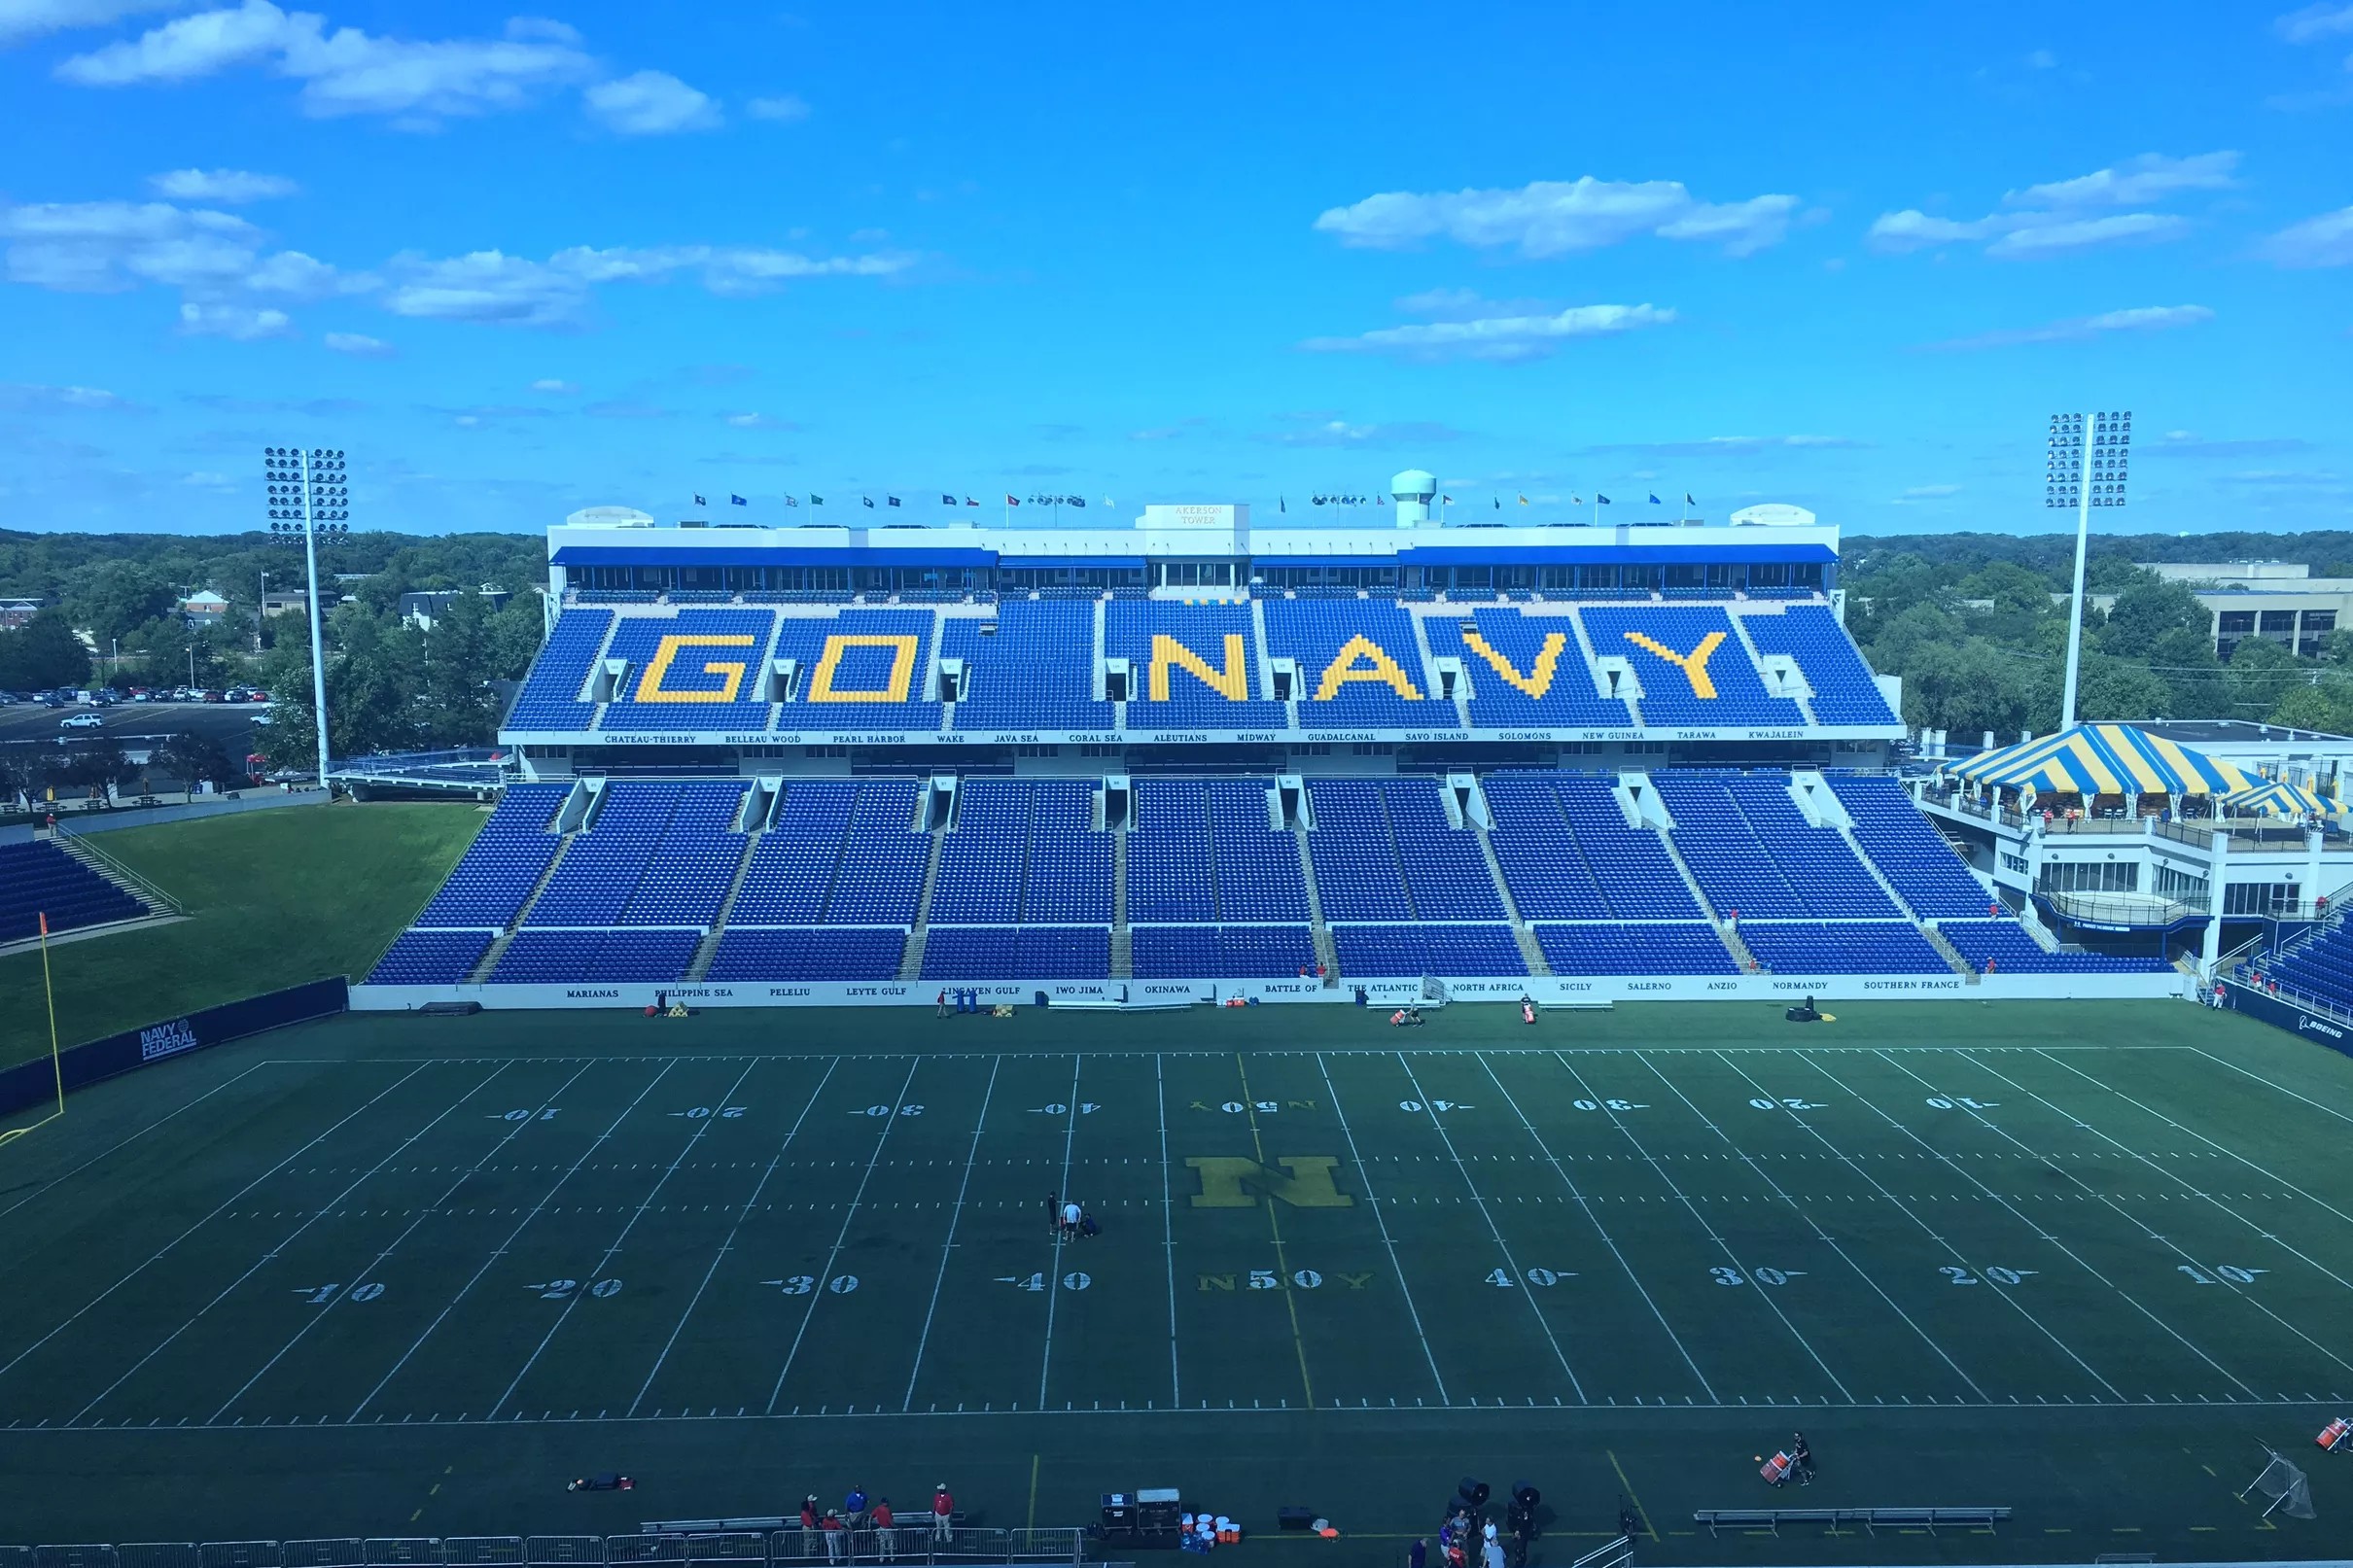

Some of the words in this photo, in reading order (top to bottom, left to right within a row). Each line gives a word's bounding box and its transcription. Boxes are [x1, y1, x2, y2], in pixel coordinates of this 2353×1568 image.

[635, 635, 918, 703] GO
[1148, 633, 1727, 702] NAVY
[567, 990, 619, 998] MARIANAS
[654, 989, 711, 997] PHILIPPINE
[1489, 983, 1524, 992] AFRICA
[1864, 981, 1917, 990] SOUTHERN
[140, 1023, 176, 1044] NAVY
[2309, 1021, 2343, 1039] BOEING
[142, 1030, 196, 1057] FEDERAL
[686, 1106, 747, 1118] 20
[866, 1104, 925, 1116] 30
[1045, 1102, 1102, 1114] 40
[1221, 1100, 1278, 1113] 50
[1399, 1100, 1455, 1112] 40
[1573, 1098, 1632, 1111] 30
[1749, 1098, 1809, 1110] 20
[1925, 1097, 1984, 1109] 10
[504, 1108, 562, 1120] 10
[1184, 1157, 1353, 1206] N
[1017, 1272, 1091, 1291] 40
[1248, 1270, 1323, 1289] 50
[1484, 1268, 1557, 1287] 40
[1708, 1267, 1787, 1286] 30
[1938, 1266, 2020, 1285] 20
[2176, 1265, 2255, 1284] 10
[306, 1283, 385, 1303] 10
[541, 1279, 623, 1299] 20
[782, 1274, 859, 1295] 30
